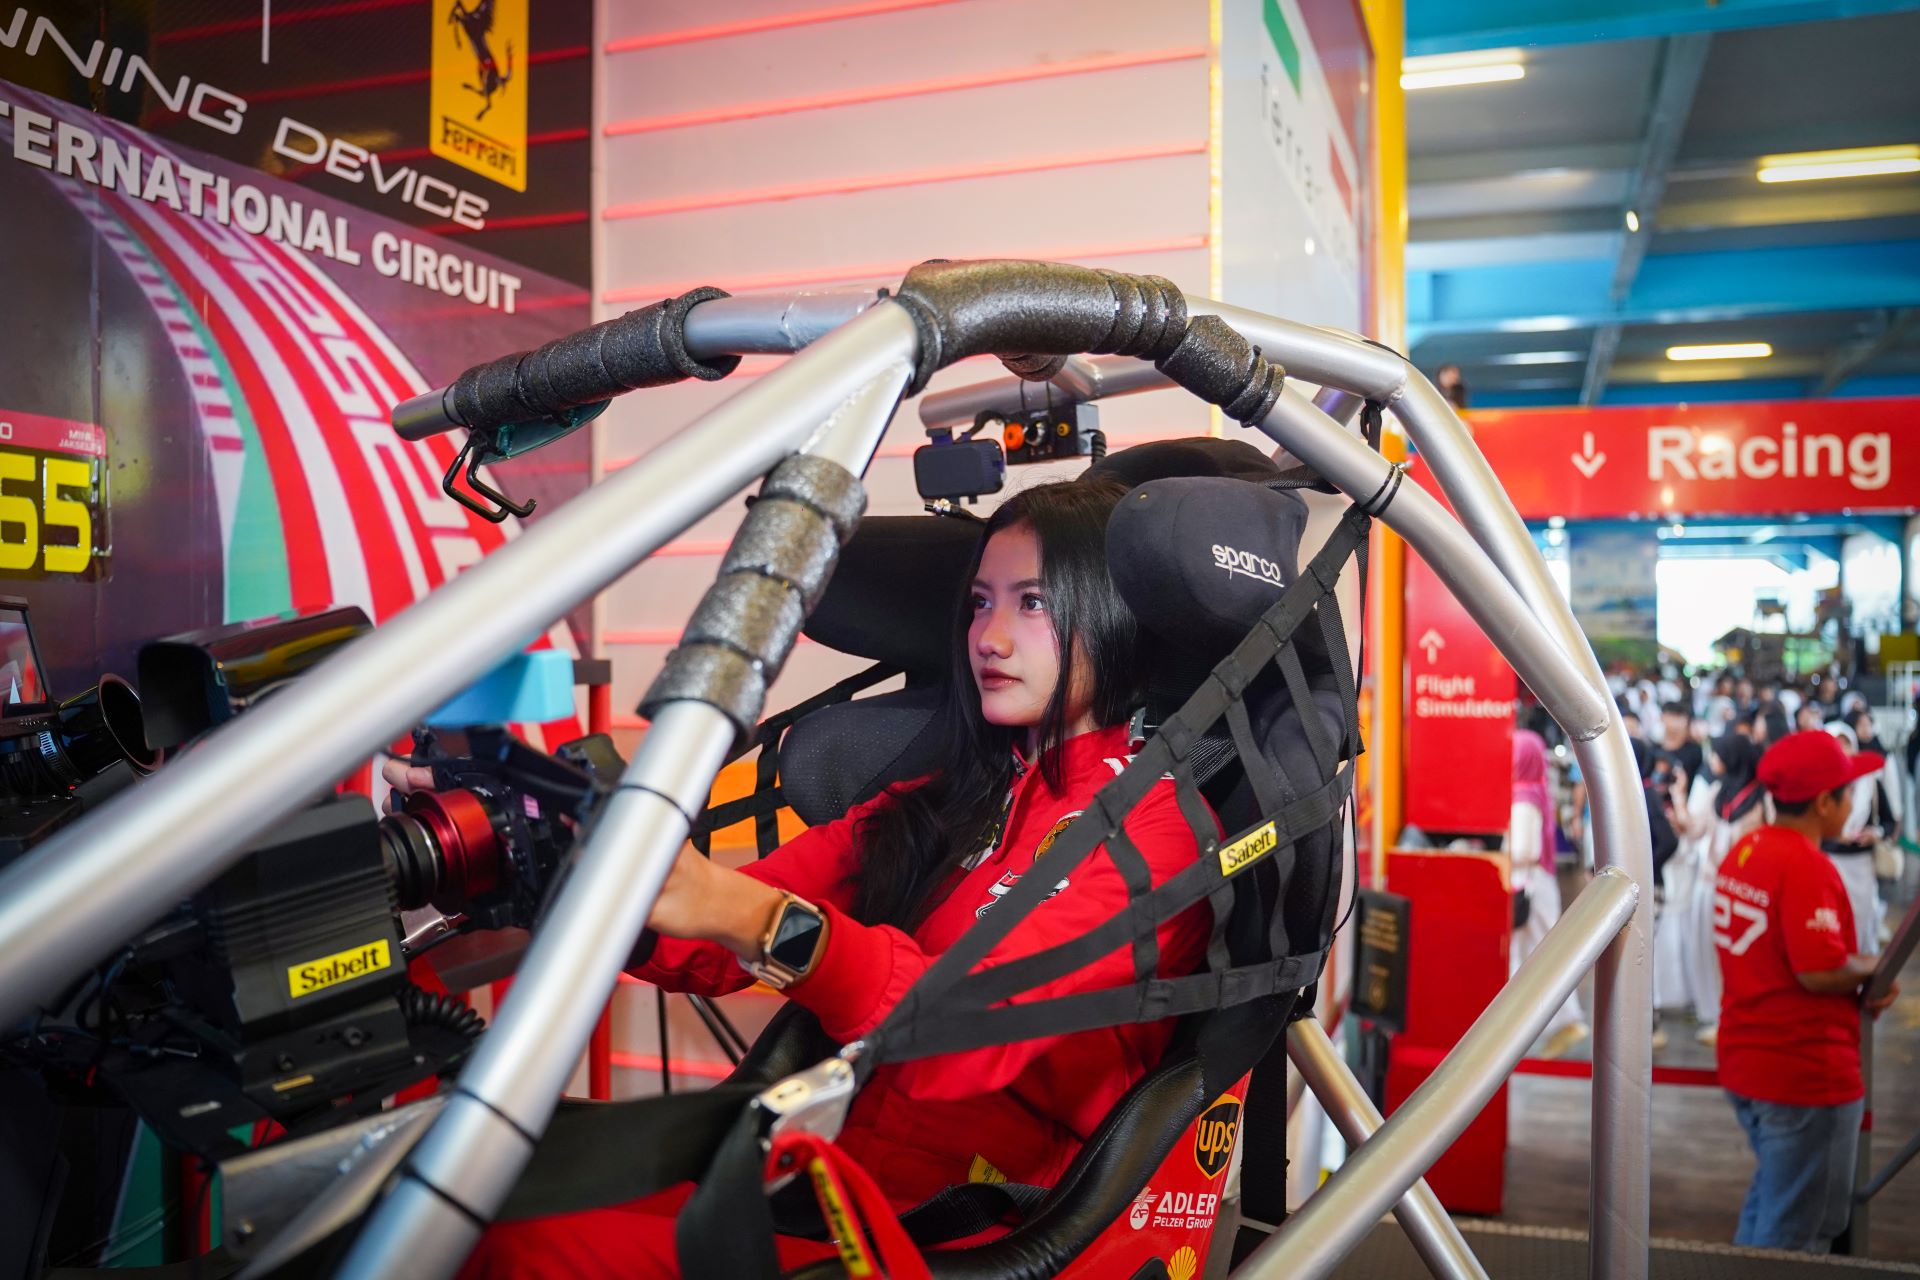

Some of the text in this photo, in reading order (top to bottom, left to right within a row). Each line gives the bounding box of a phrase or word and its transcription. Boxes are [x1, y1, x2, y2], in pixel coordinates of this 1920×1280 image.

[442, 115, 517, 176] Ferrari
[272, 117, 490, 230] DEVICE
[0, 101, 522, 314] ERNATIONAL CIRCUIT
[1647, 422, 1892, 491] Racing
[1211, 544, 1283, 583] sparco
[1416, 674, 1476, 699] Flight
[1416, 697, 1512, 718] Simulator
[1226, 830, 1272, 869] Sabelt
[1714, 893, 1769, 956] 27
[300, 947, 380, 989] Sabelt
[1198, 1119, 1236, 1166] ups
[1152, 1215, 1214, 1231] PELZER GROUP
[1156, 1191, 1218, 1216] ADLER
